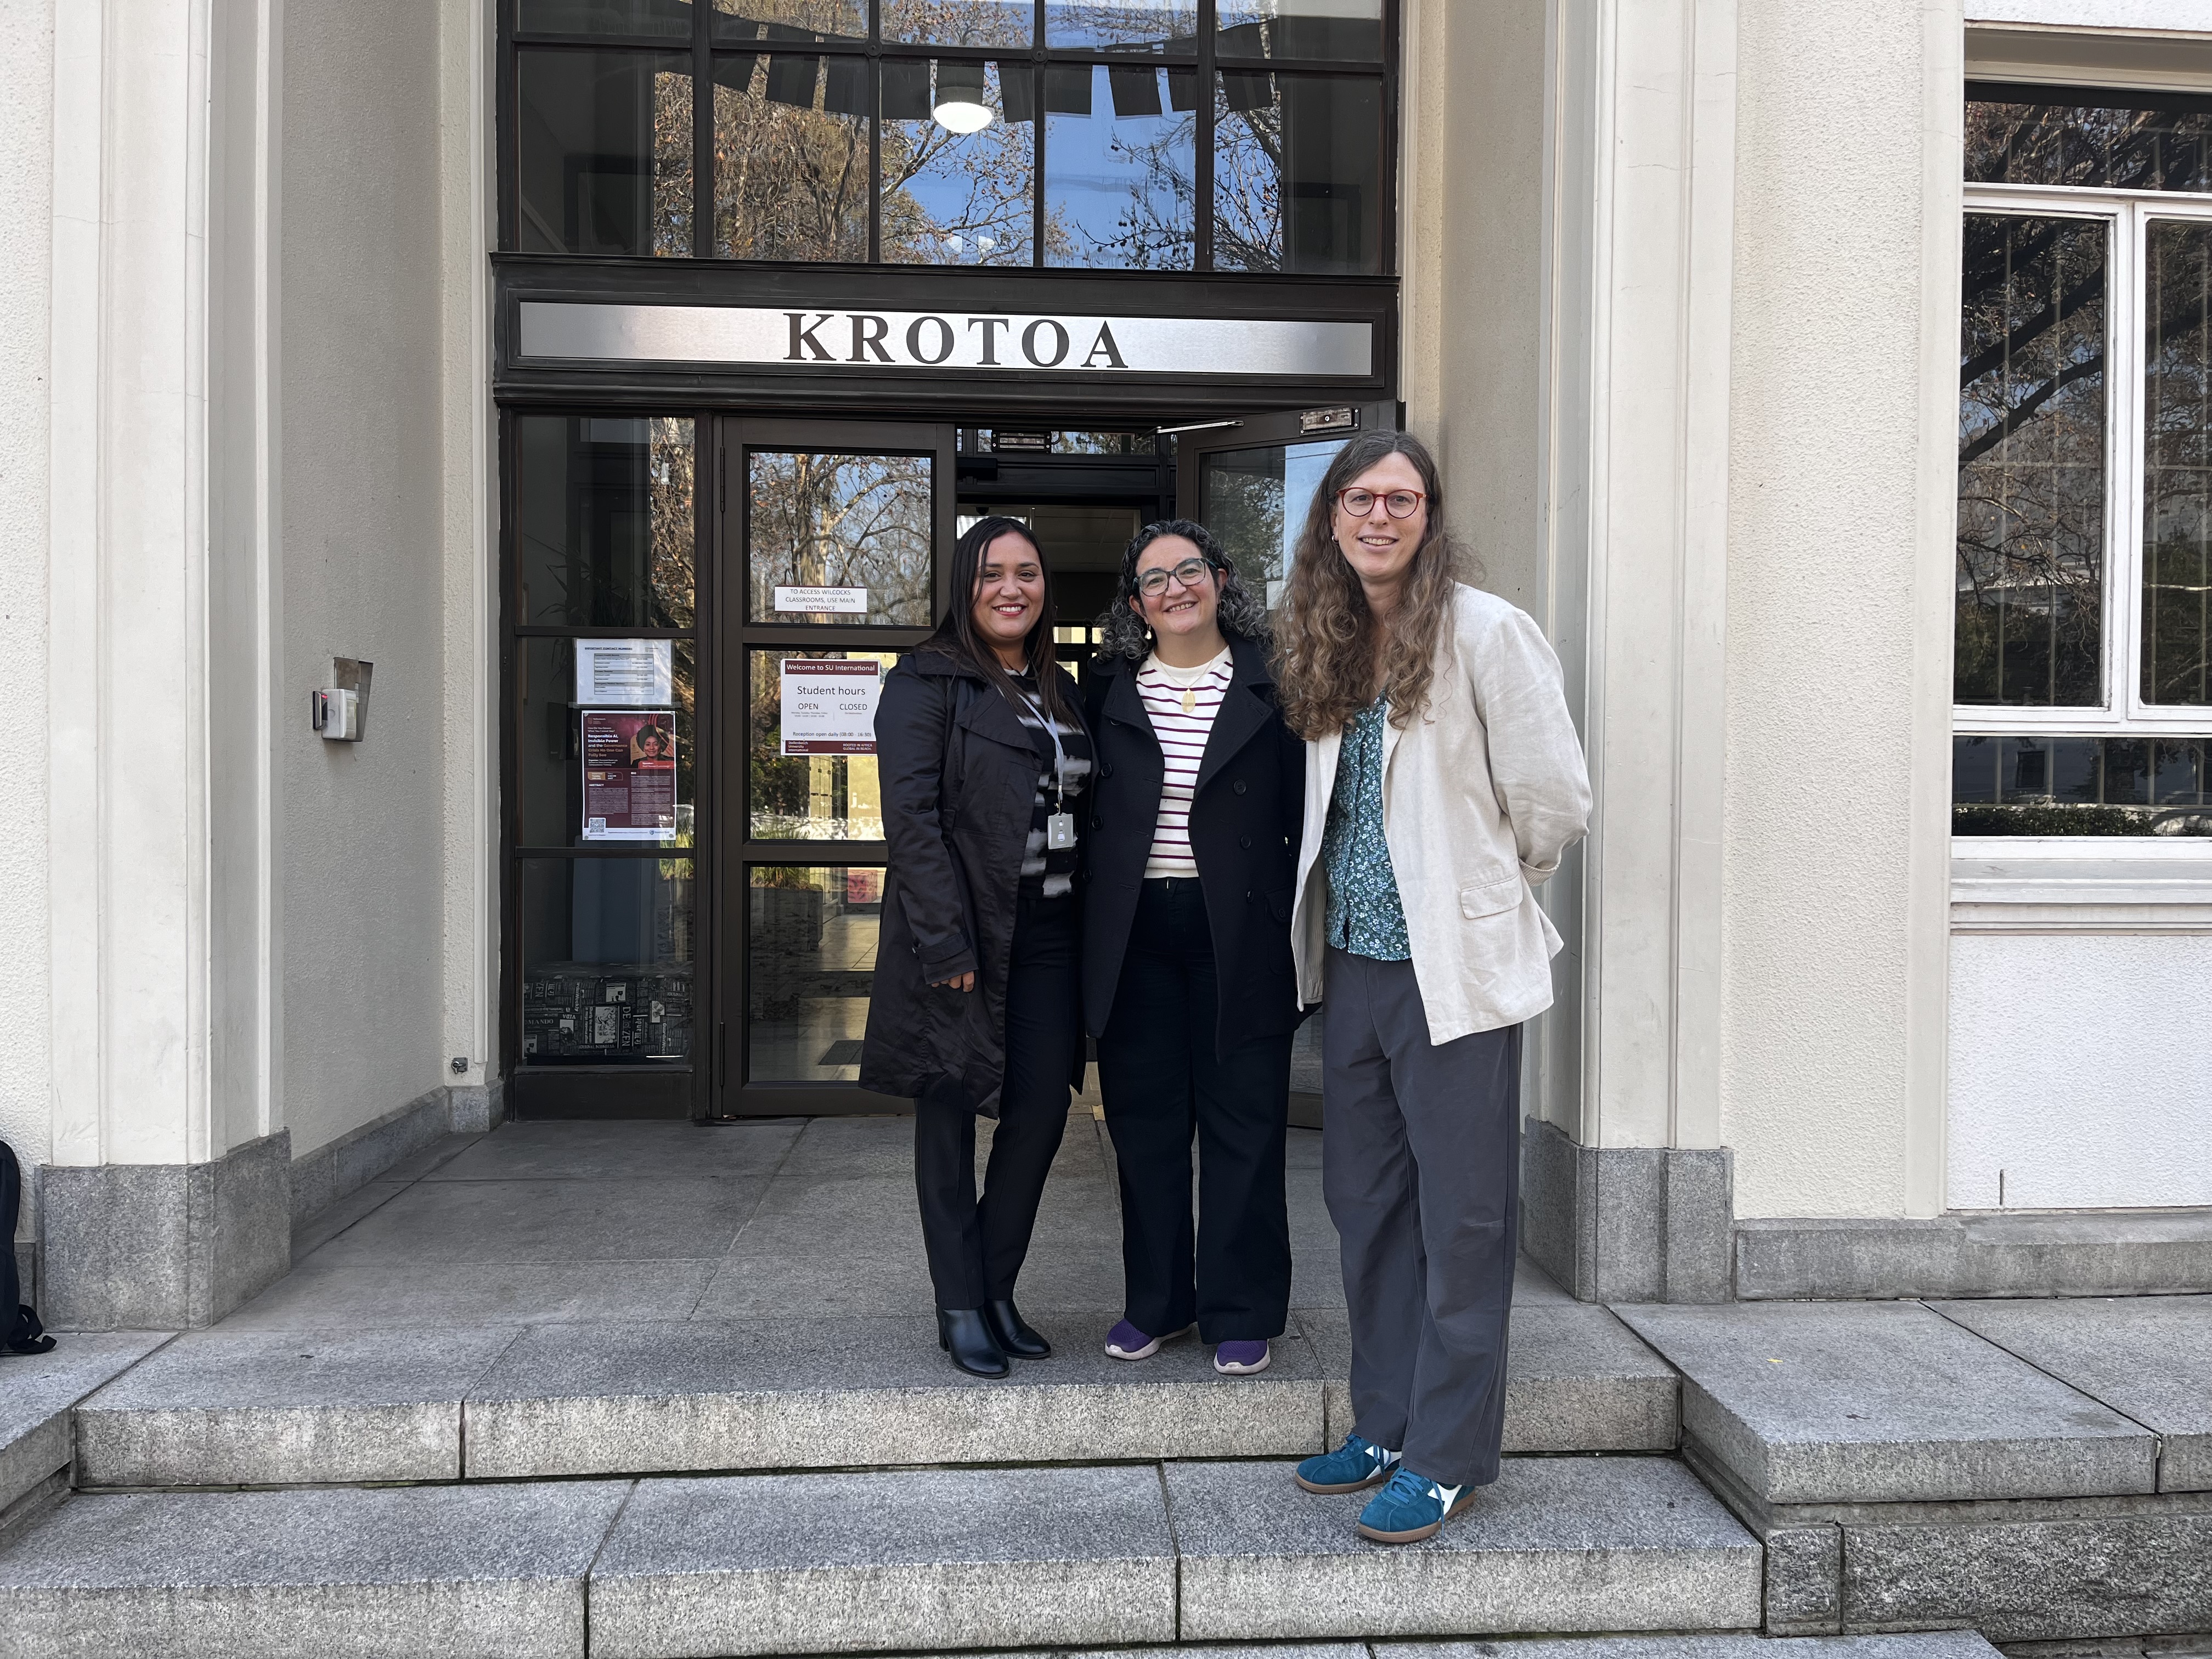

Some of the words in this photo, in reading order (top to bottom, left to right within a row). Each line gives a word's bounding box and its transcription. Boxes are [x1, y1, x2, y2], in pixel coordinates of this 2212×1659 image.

[783, 313, 1128, 368] KROTOA
[797, 686, 835, 695] Student
[838, 686, 866, 695] hours
[622, 1006, 631, 1019] DE
[622, 1030, 630, 1047] ZEN
